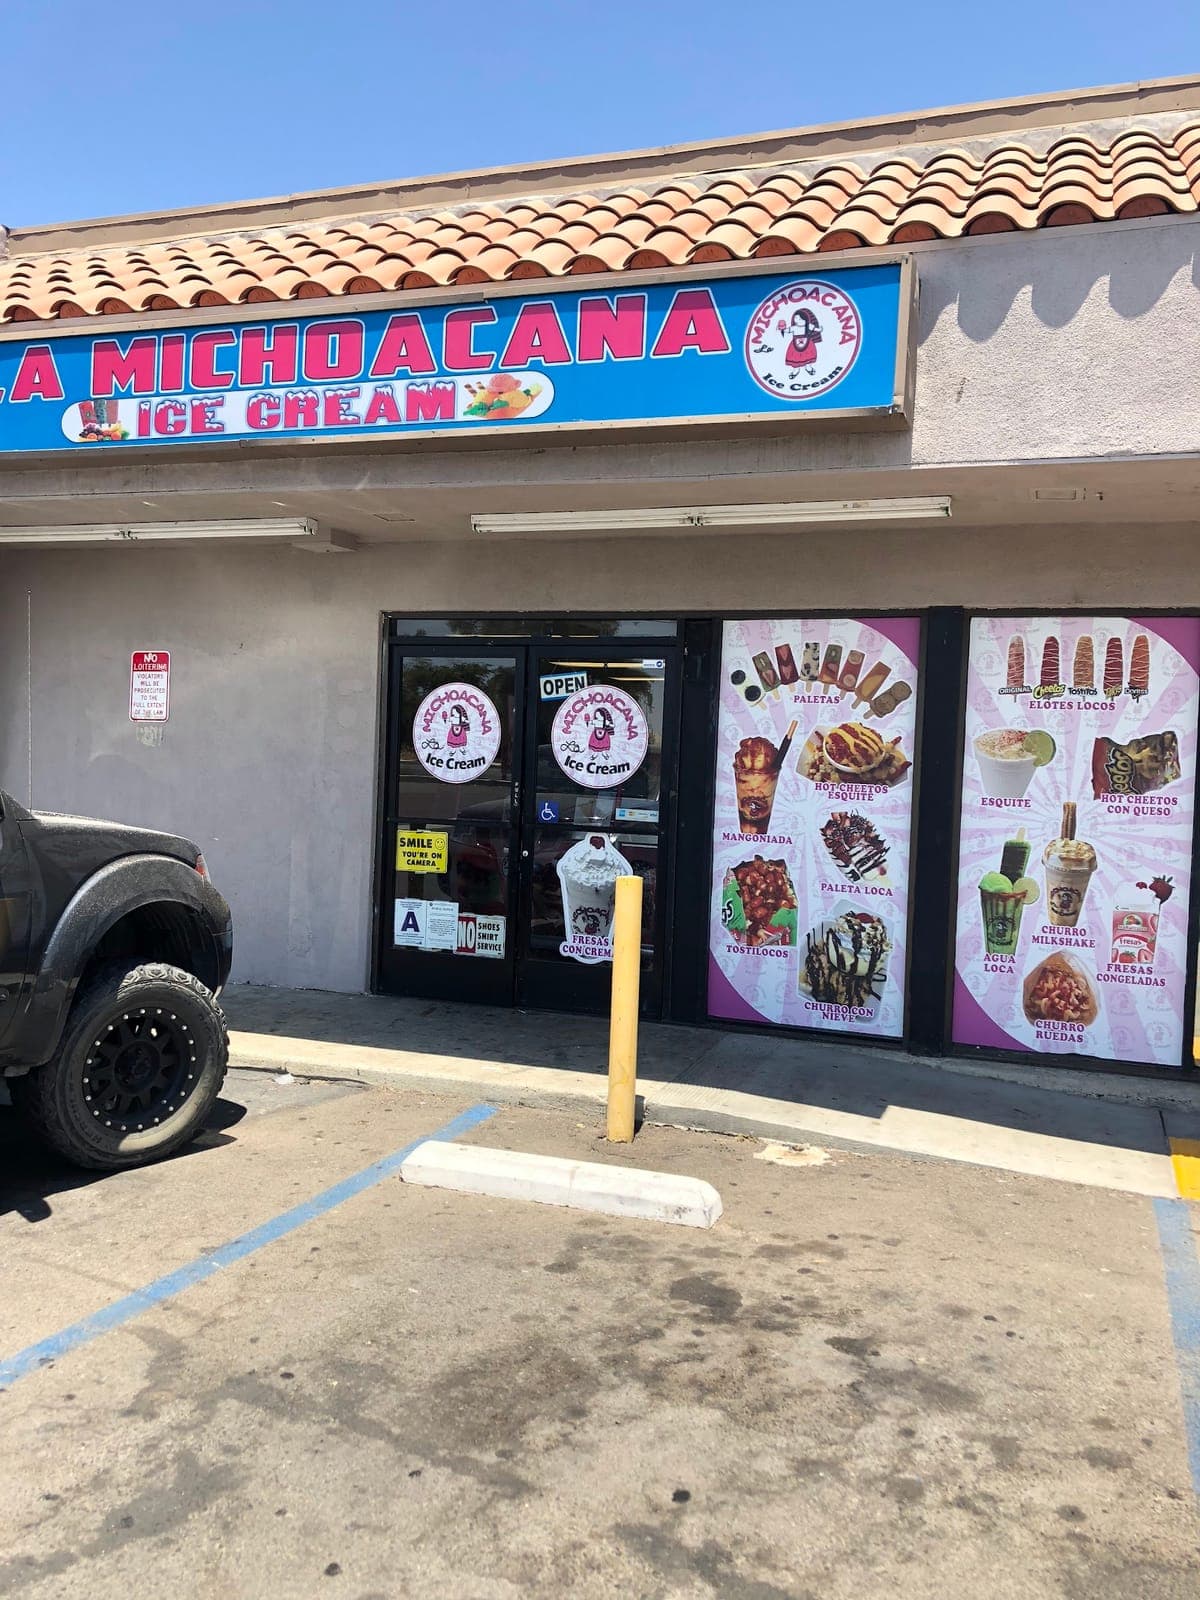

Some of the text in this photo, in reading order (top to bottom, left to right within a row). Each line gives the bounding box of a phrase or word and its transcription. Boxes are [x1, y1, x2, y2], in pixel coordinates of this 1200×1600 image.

[751, 286, 857, 345] MICHOACANA
[0, 286, 731, 403] A MICHOACANA
[762, 365, 844, 391] Ice Cream
[137, 380, 456, 437] ICE CREAM
[144, 654, 158, 663] NO
[543, 676, 585, 695] OPEN
[999, 685, 1031, 695] ORIGINAL
[793, 695, 840, 704] PALETAS
[422, 689, 492, 735] MICHOACANA
[1029, 701, 1116, 711] ELOTES LOCOS
[562, 692, 638, 740] MICHOACANA
[425, 753, 486, 770] Ice Cream
[564, 755, 630, 775] Ice Cream
[814, 783, 889, 794] HOT CHEETOS
[827, 792, 874, 802] ESQUITE
[981, 798, 1031, 808] ESQUITE
[1101, 794, 1178, 806] HOT CHEETOS
[1107, 805, 1171, 817] CON QUESO
[399, 837, 433, 848] SMILE
[722, 832, 793, 845] MANGONIADA
[402, 851, 442, 860] YOU'RE ON
[406, 859, 436, 867] CAMERA
[821, 883, 894, 897] PALETA LOCA
[400, 911, 421, 933] A
[478, 922, 500, 931] SHOES
[457, 920, 476, 949] NO
[477, 933, 498, 941] SHIRT
[1041, 925, 1087, 937] CHURRO
[572, 935, 609, 947] FRESAS
[1032, 935, 1096, 949] MILKSHAKE
[477, 943, 502, 952] SERVICE
[562, 944, 613, 957] CON CREM
[726, 945, 789, 958] TOSTILOCOS
[983, 953, 1016, 964] AGUA
[984, 964, 1014, 974] LOCA
[1106, 963, 1153, 975] FRESAS
[1096, 973, 1166, 987] CONGELADAS
[804, 1002, 874, 1017] CHURRO CON
[822, 1011, 856, 1022] NIEVE
[1035, 1020, 1085, 1033] CHURRO
[1035, 1032, 1084, 1043] RUEDAS
